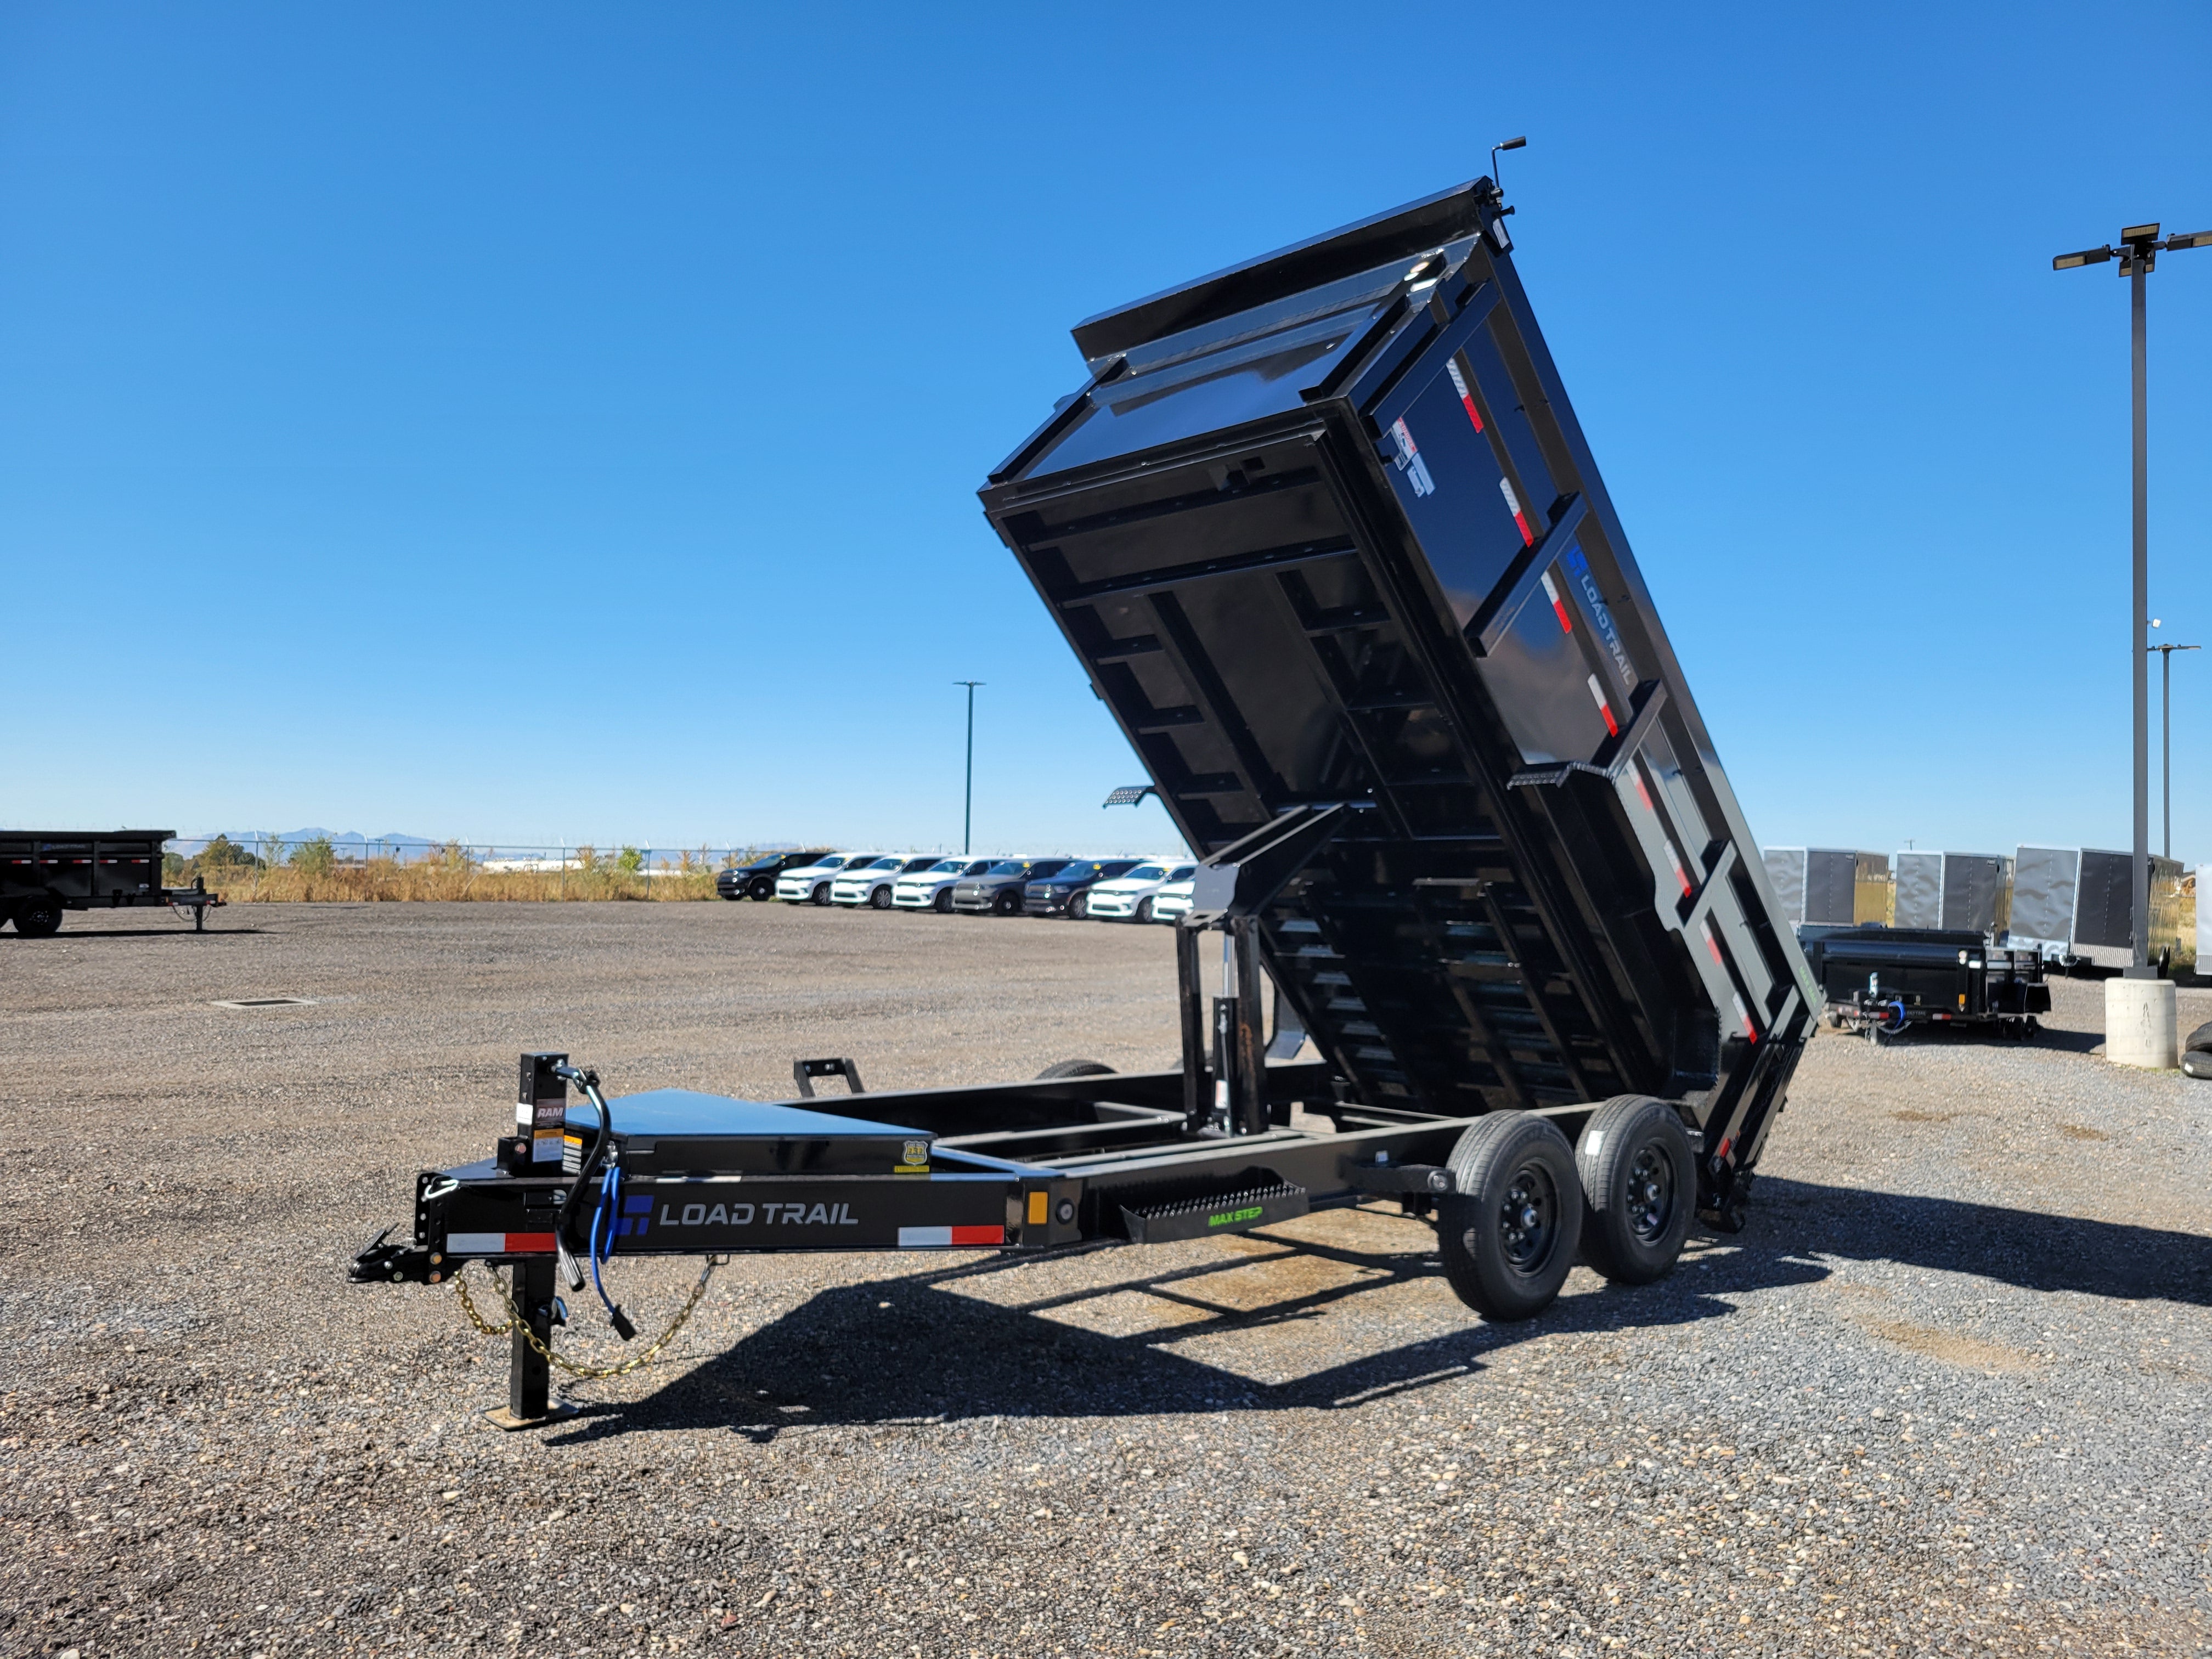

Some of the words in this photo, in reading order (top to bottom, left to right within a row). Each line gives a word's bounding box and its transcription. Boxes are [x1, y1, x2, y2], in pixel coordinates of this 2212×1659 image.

[1581, 574, 1609, 629] LOAD
[1606, 627, 1631, 685] TRAIL
[537, 1107, 564, 1118] RAM
[659, 1203, 755, 1226] LOAD
[762, 1203, 859, 1224] TRAIL
[1208, 1211, 1234, 1227] MAX
[1234, 1206, 1263, 1222] STEP
